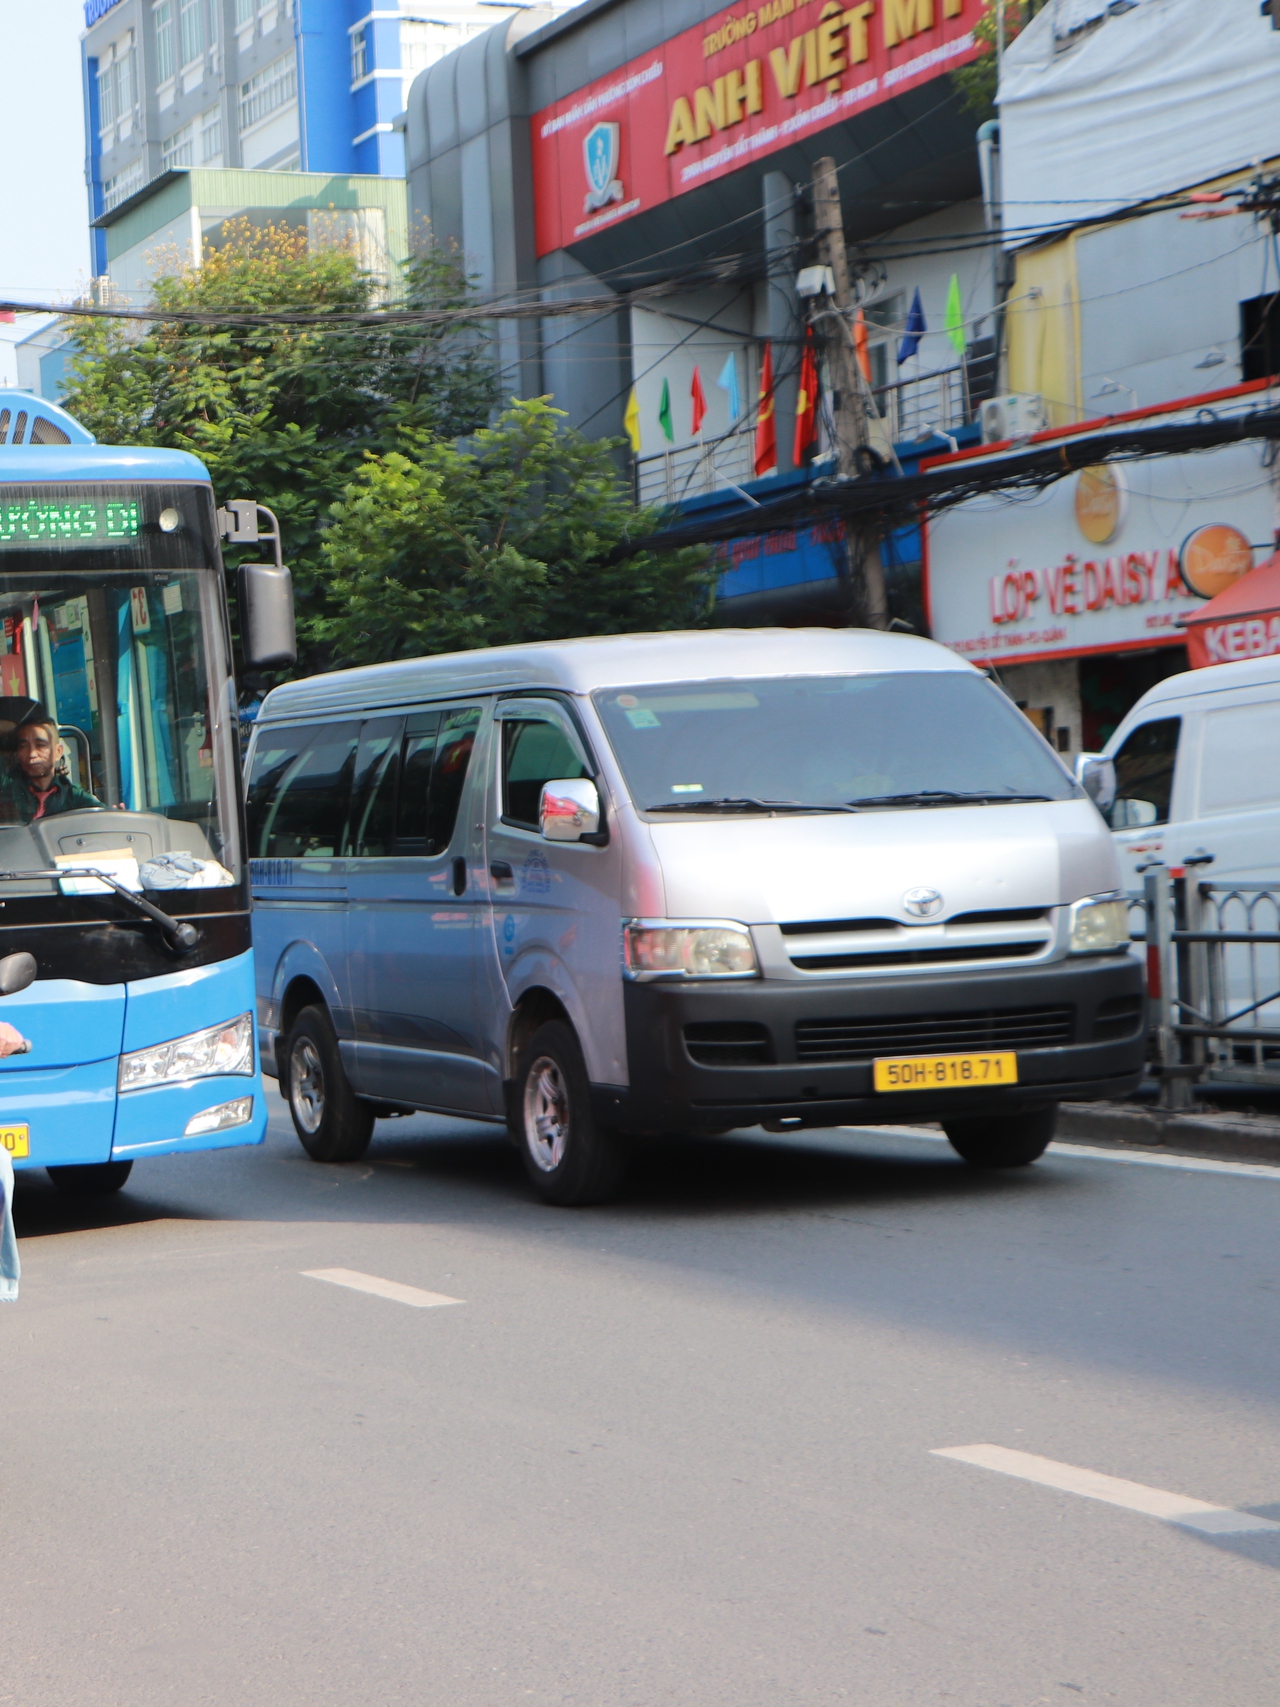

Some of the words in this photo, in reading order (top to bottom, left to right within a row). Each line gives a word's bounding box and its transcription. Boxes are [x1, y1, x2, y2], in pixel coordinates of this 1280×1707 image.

[666, 60, 762, 155] ANH
[769, 1, 875, 98] VIỆT
[989, 556, 1039, 624] LỚP
[1082, 549, 1161, 612] DAISY
[888, 1058, 1003, 1084] 50H-818.71
